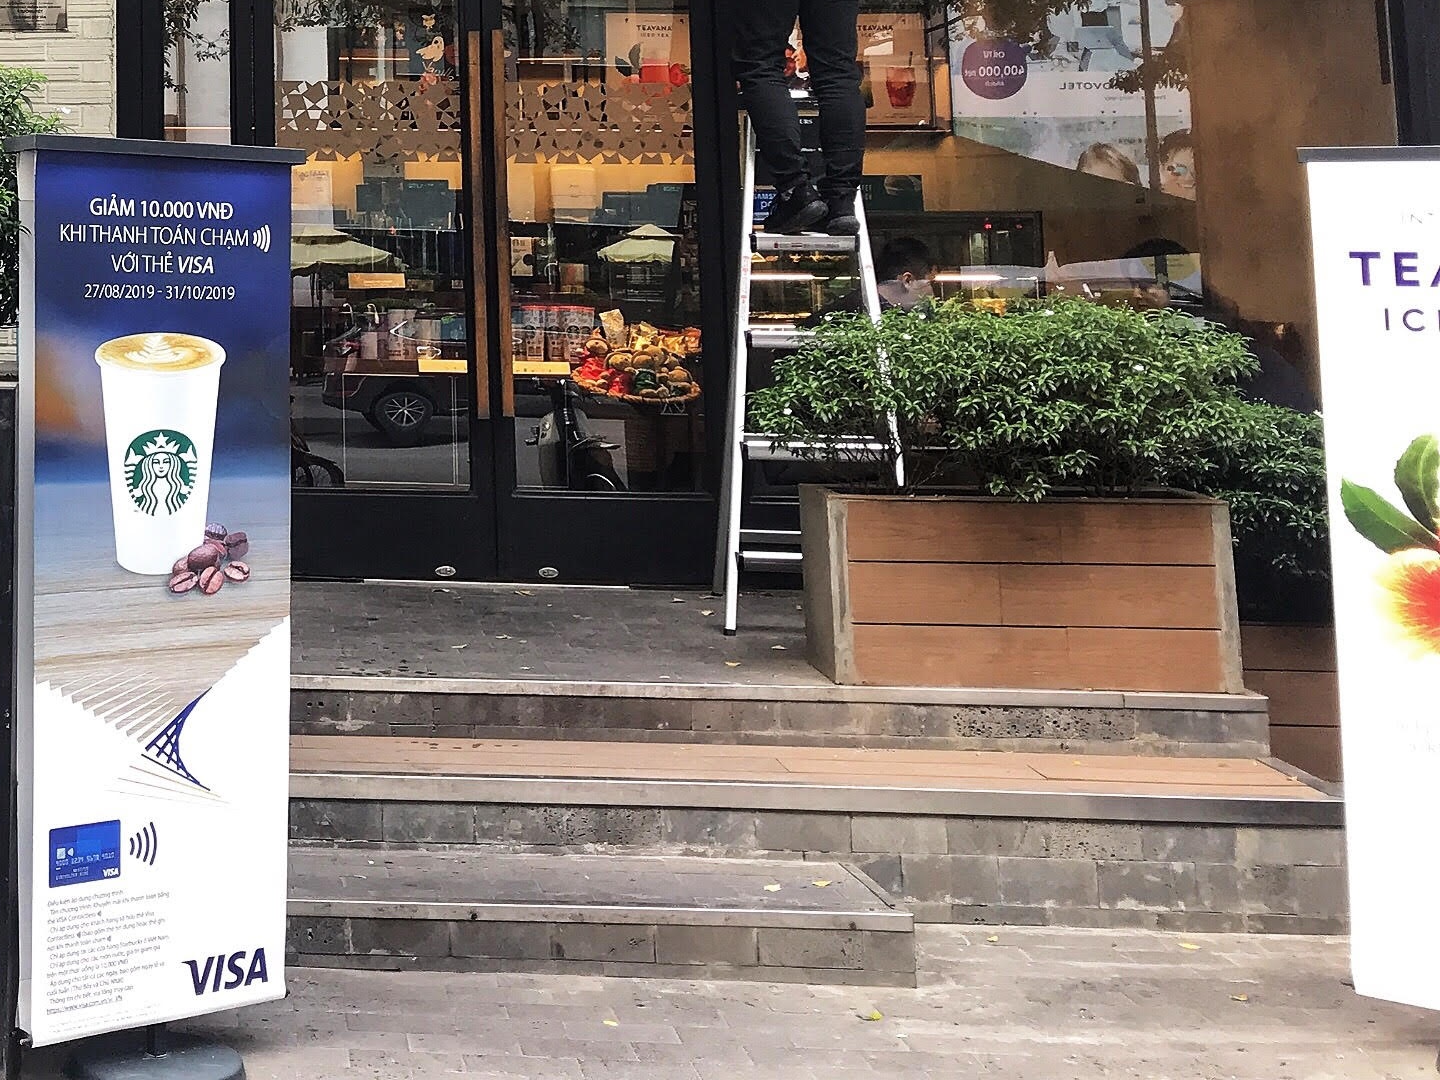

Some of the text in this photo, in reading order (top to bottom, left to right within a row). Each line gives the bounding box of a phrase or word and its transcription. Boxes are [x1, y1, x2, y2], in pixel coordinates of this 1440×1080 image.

[89, 194, 234, 220] GIẢM 10.000 VNĐ
[60, 224, 249, 250] KHI THANH TOÁN CHẠM
[111, 251, 215, 274] VỚI THẺ VISA
[1349, 251, 1440, 287] TE
[84, 284, 155, 299] 27/08/2019
[165, 285, 236, 300] 31/10/2019
[1384, 307, 1440, 332] IC
[102, 867, 119, 877] VISA
[181, 948, 269, 996] VISA
